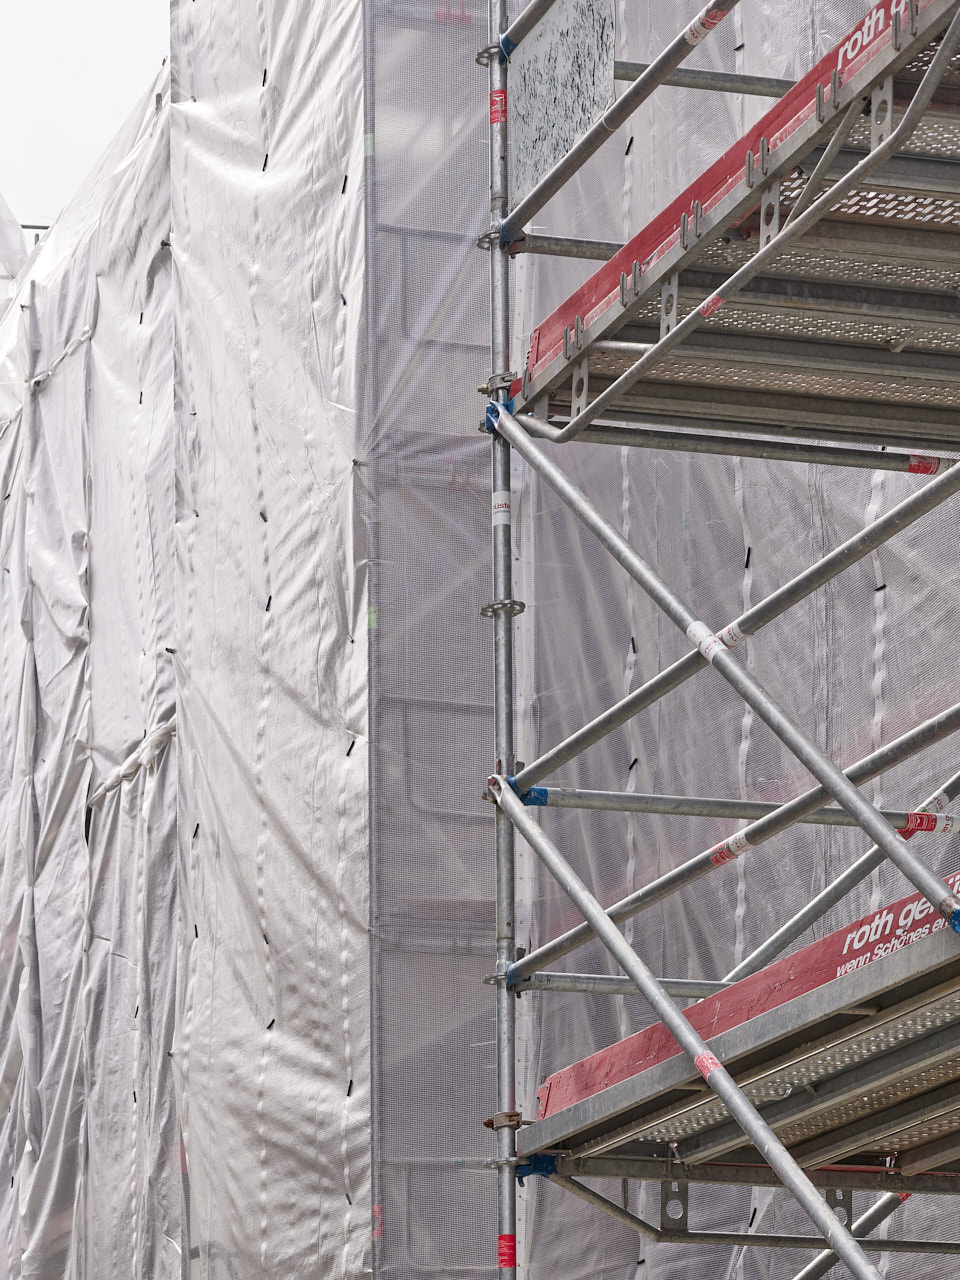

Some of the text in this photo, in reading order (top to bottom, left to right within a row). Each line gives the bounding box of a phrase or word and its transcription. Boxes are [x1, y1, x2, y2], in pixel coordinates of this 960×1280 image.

[837, 8, 885, 71] roth
[842, 909, 894, 955] roth
[836, 952, 871, 977] wenn
